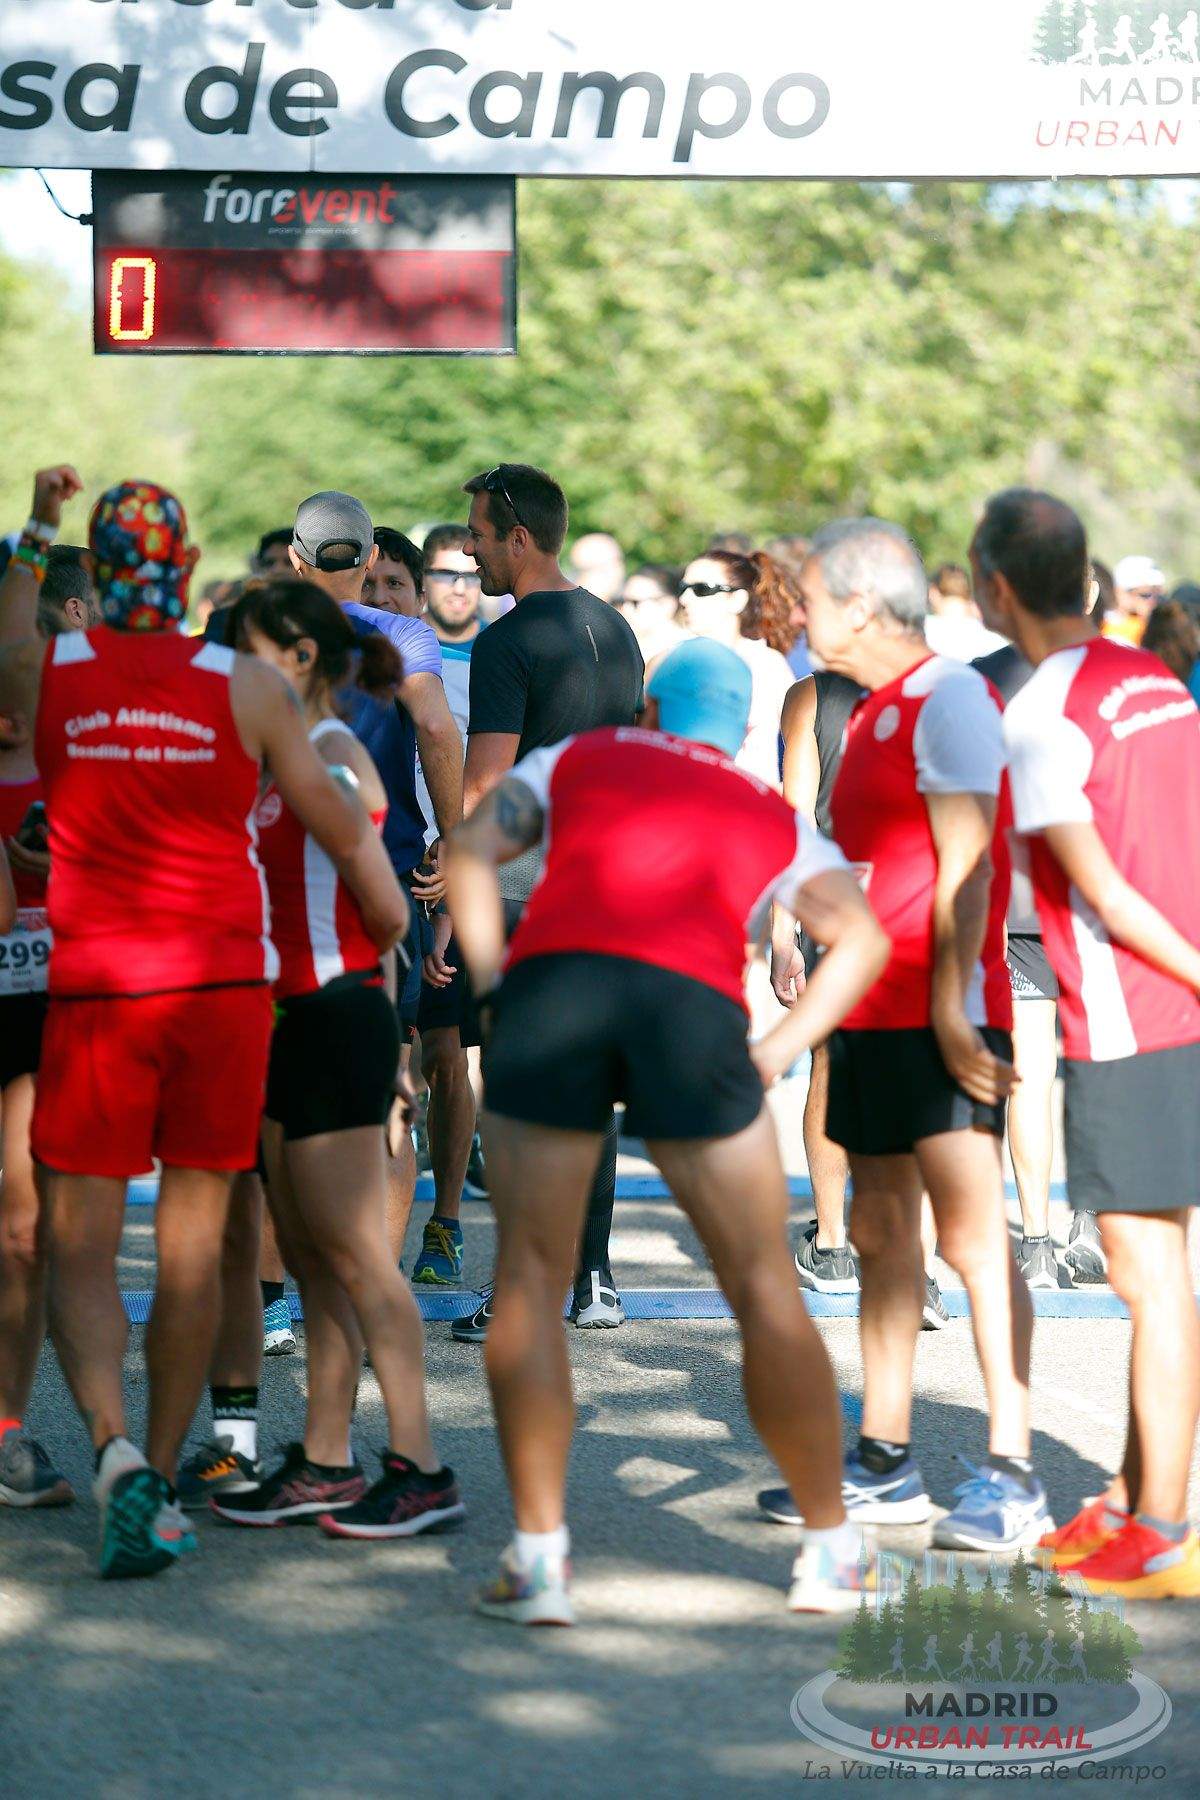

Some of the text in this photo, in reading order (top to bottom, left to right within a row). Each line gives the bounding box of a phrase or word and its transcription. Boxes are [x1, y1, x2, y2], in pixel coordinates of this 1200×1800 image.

[184, 43, 339, 137] de
[384, 48, 831, 162] Campo
[1035, 119, 1181, 147] URBAN
[203, 174, 398, 224] forevent
[110, 257, 156, 341] 0
[64, 706, 217, 743] Club Atletismo
[134, 745, 161, 762] del
